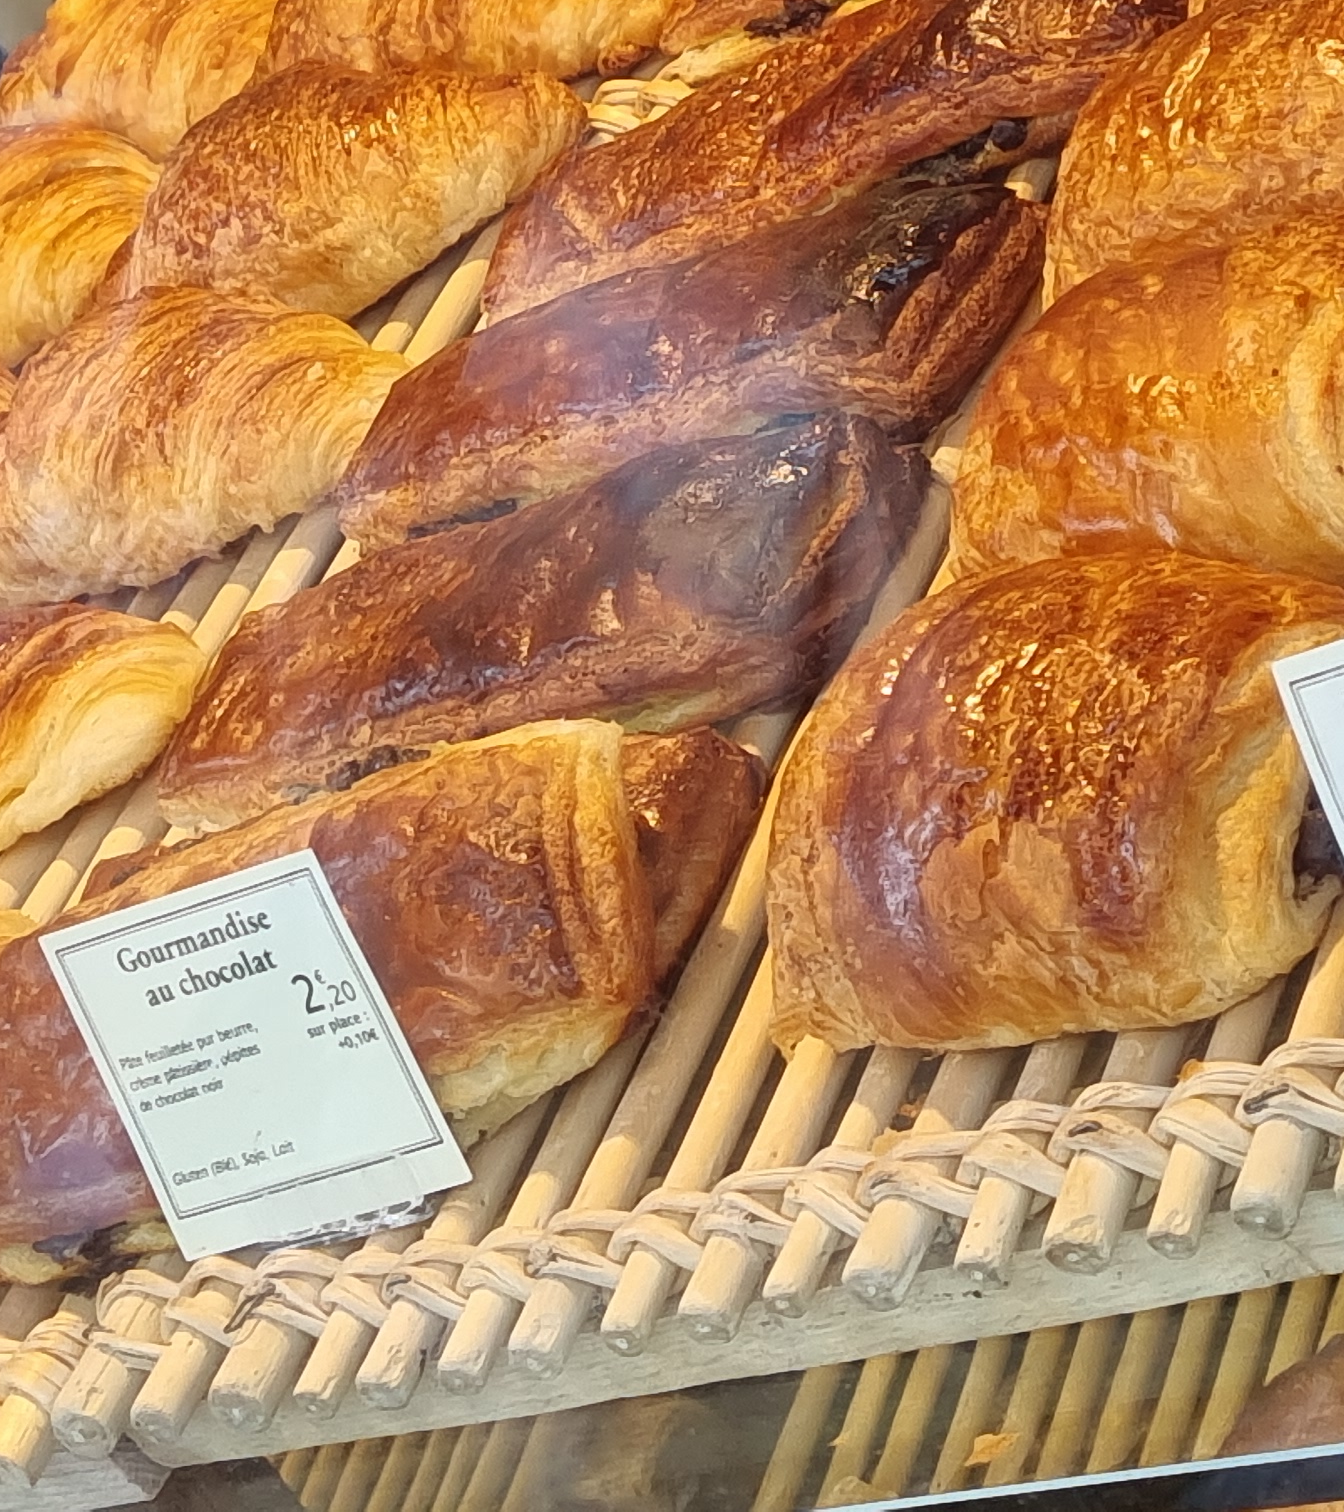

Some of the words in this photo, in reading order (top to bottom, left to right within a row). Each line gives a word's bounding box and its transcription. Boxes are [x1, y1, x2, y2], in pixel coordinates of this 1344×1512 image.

[116, 910, 272, 973] Gourmandise
[145, 984, 176, 1007] au
[178, 948, 278, 996] chocolat
[196, 1034, 215, 1051] pur
[215, 1022, 259, 1042] beurre,
[307, 1025, 326, 1038] sur
[328, 1014, 362, 1035] place
